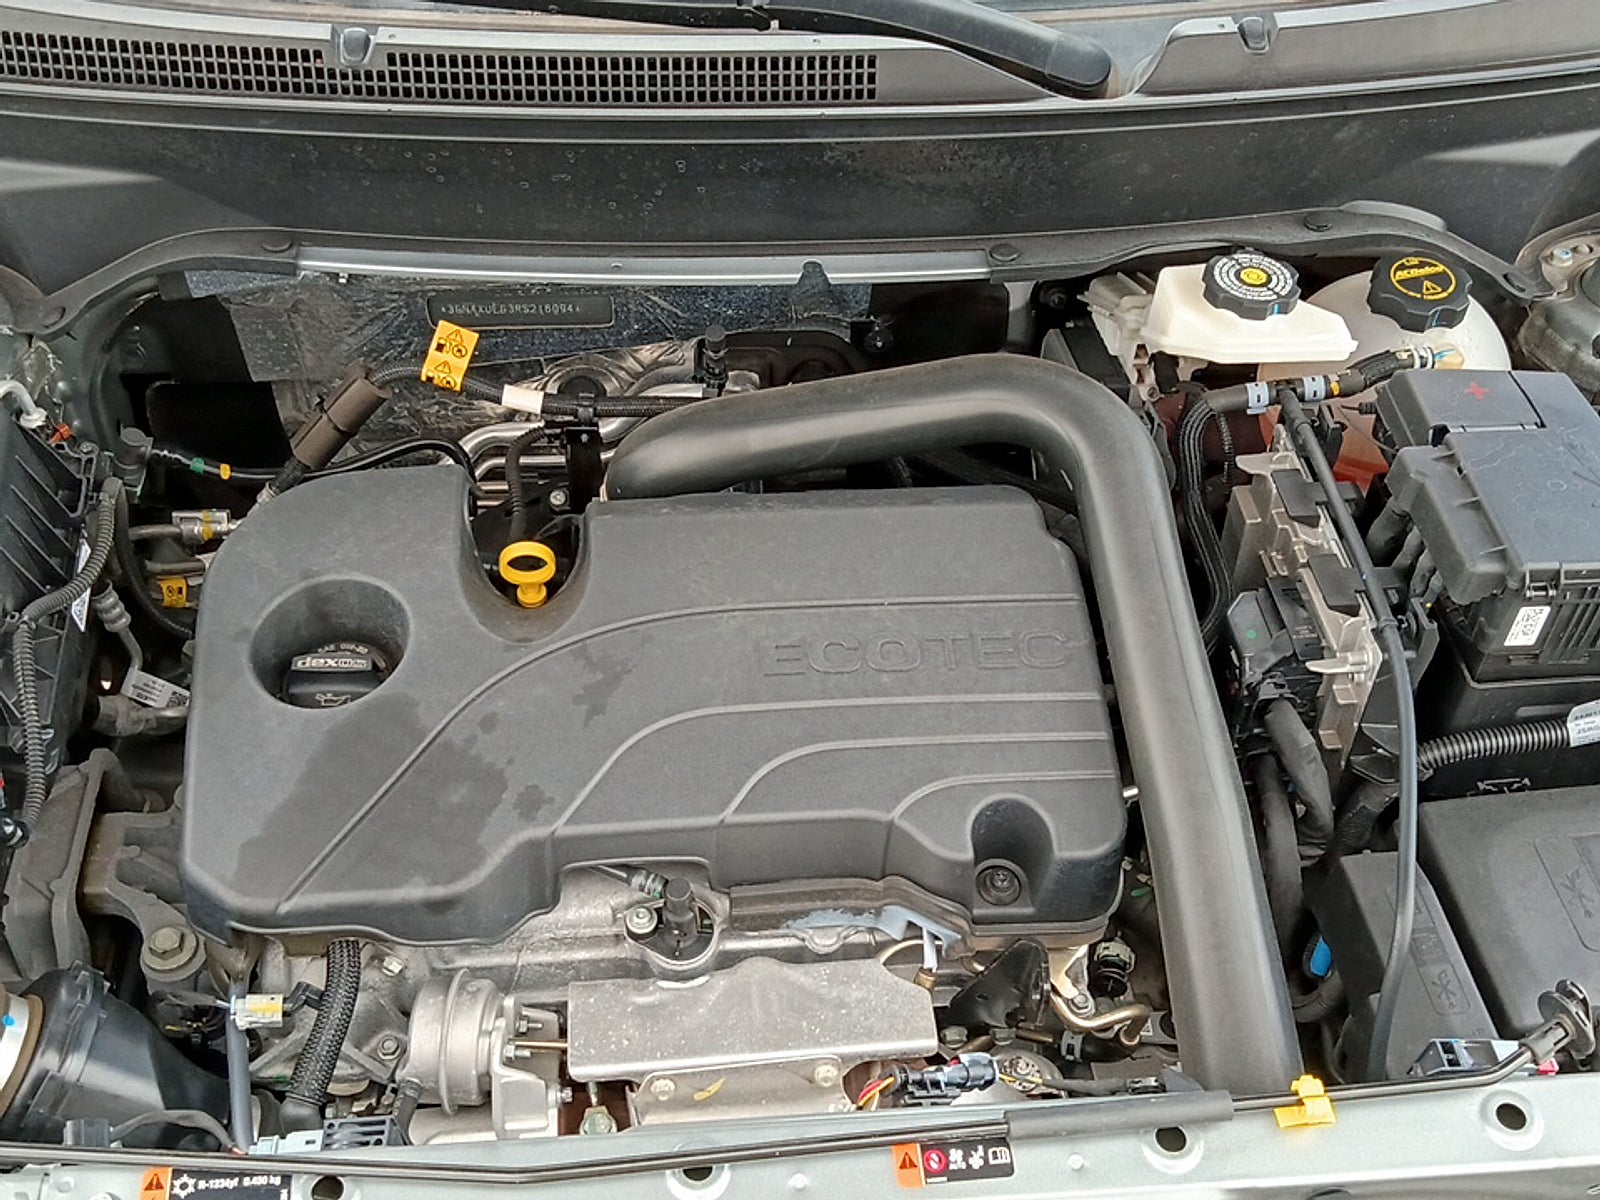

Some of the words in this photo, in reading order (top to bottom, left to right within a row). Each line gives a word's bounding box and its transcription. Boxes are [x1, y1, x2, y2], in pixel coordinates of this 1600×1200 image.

[763, 630, 1068, 675] ECOTEC
[197, 1177, 239, 1189] R-1234yf
[269, 1174, 281, 1186] kg
